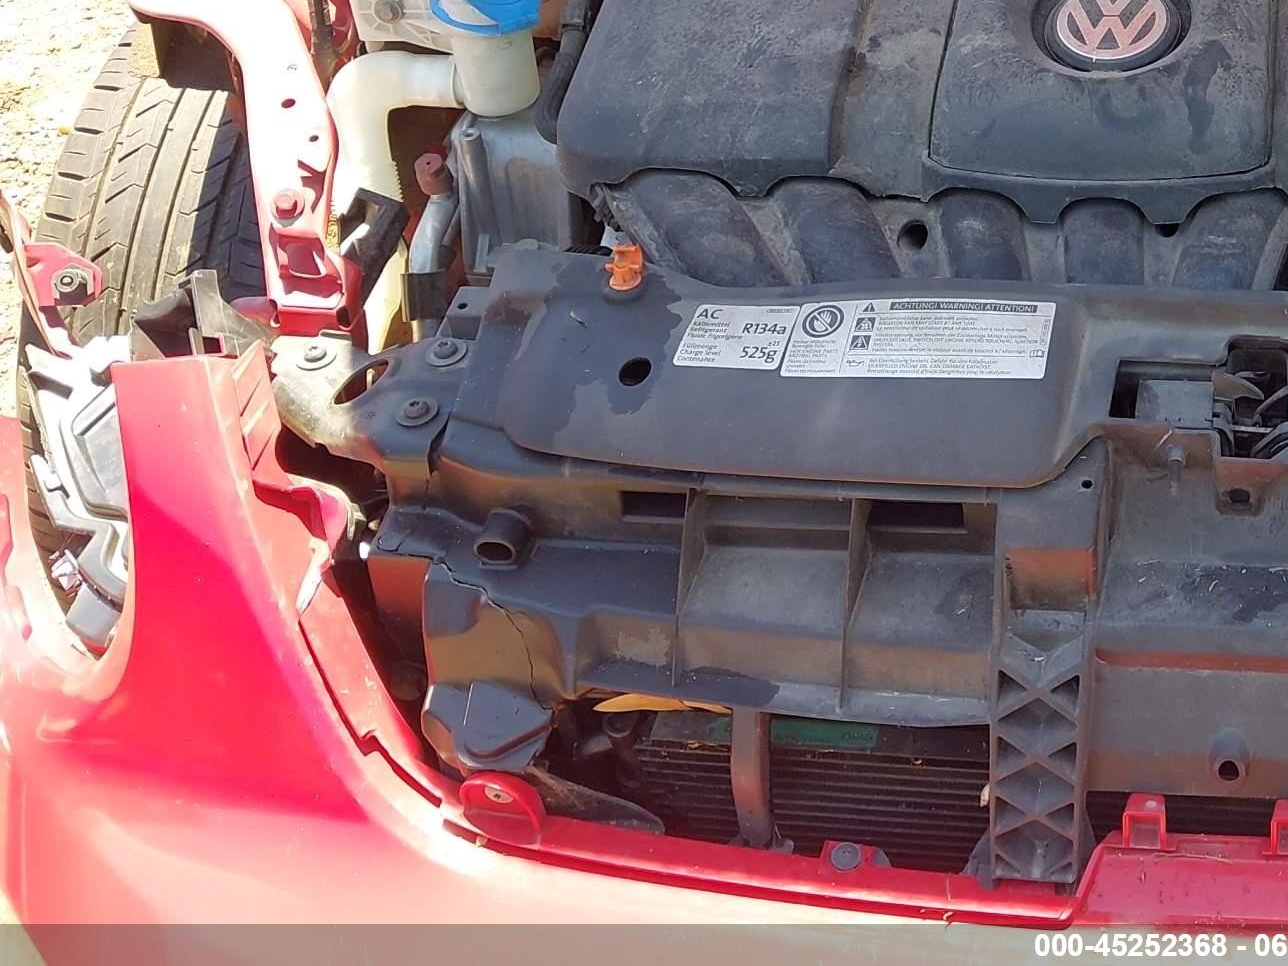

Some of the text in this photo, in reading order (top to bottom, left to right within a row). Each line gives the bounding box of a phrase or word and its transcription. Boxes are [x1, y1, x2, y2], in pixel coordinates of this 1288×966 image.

[893, 301, 1035, 314] ACHTUNG! WARNING! ATTENTION!
[696, 308, 724, 320] AC
[742, 323, 787, 335] R134a
[739, 346, 778, 363] 525g
